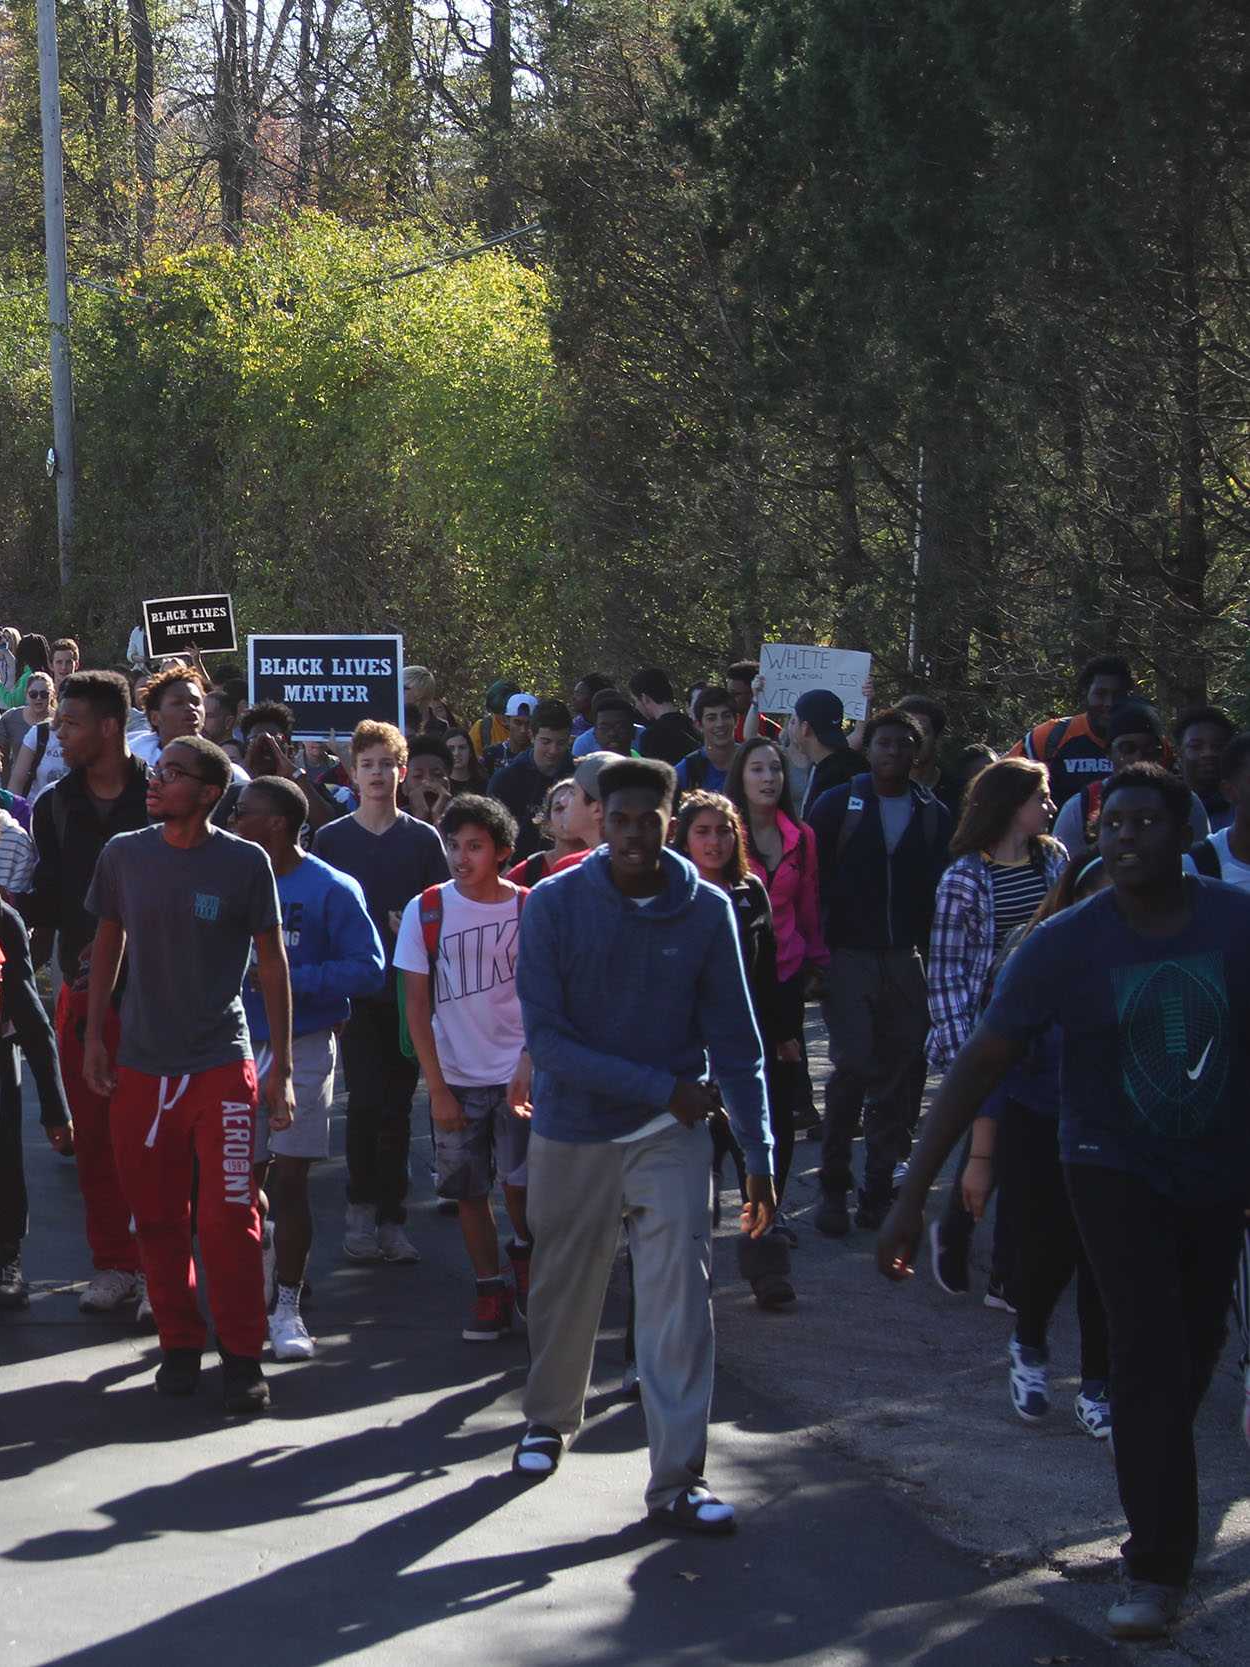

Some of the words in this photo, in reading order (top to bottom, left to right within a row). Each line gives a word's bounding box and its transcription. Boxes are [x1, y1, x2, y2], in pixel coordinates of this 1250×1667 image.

[151, 609, 188, 622] BLACK
[191, 607, 227, 619] LIVES
[166, 622, 216, 635] MATTER
[765, 645, 831, 669] WHITE
[259, 658, 324, 675] BLACK
[331, 658, 392, 675] LIVES
[837, 673, 859, 687] IS
[283, 685, 369, 702] MATTER
[434, 918, 519, 1004] NIK
[221, 1100, 251, 1158] AERO
[224, 1175, 251, 1205] NY
